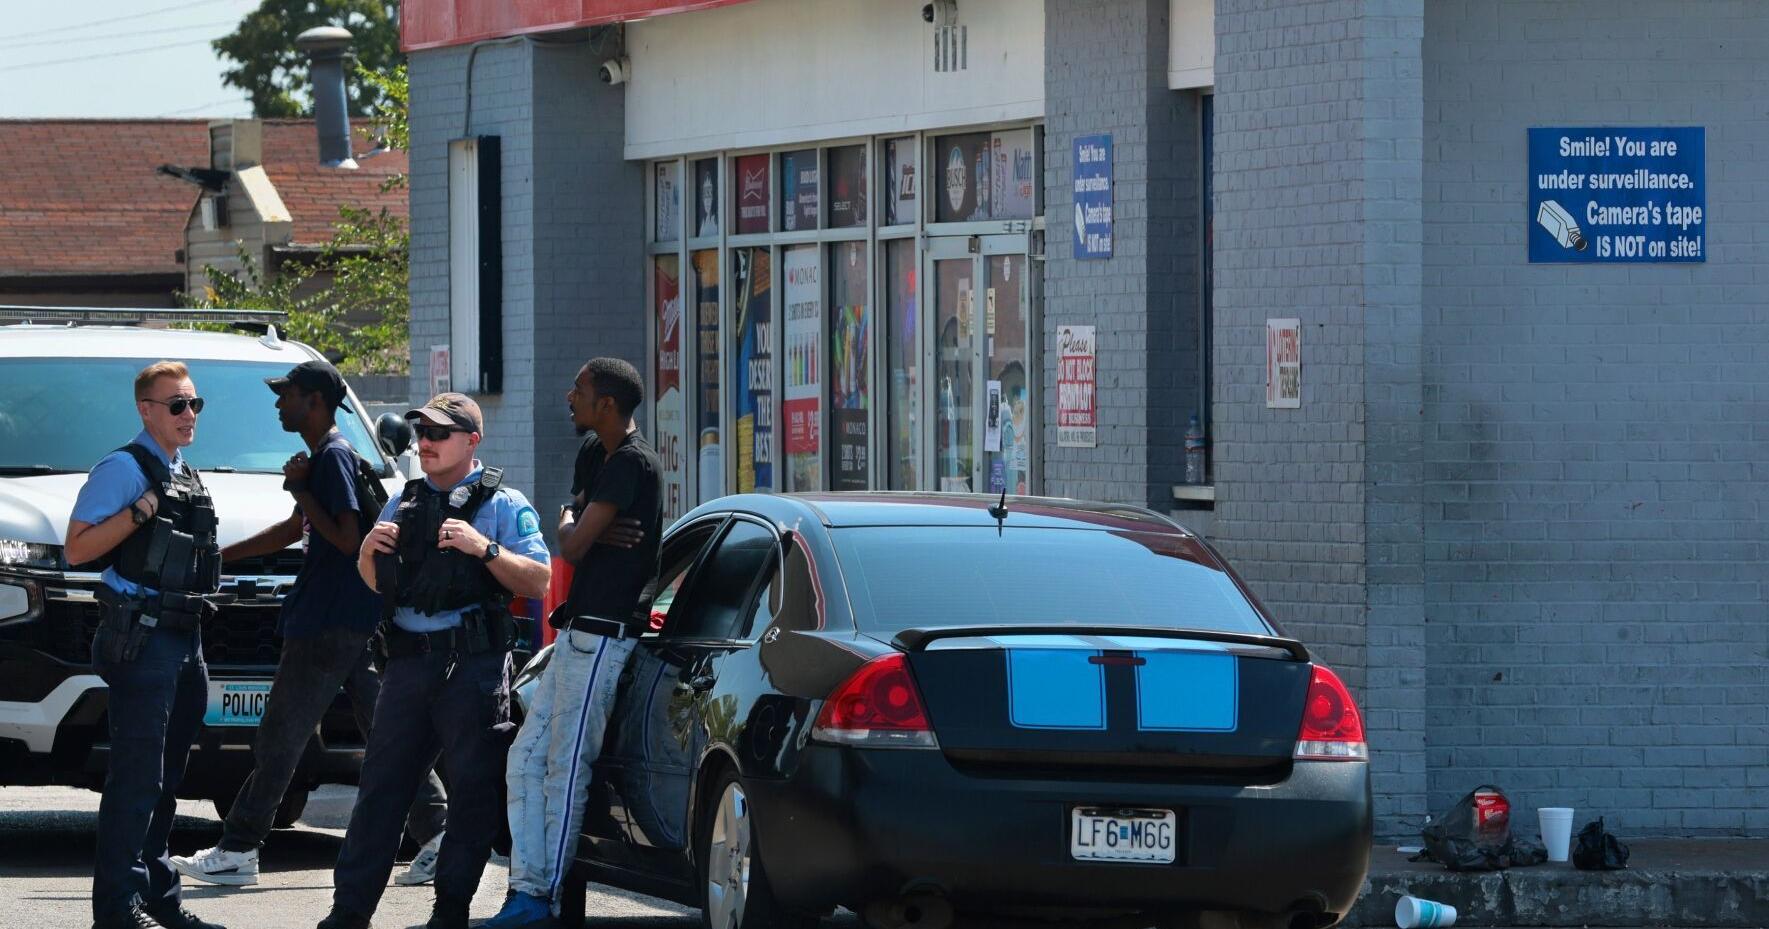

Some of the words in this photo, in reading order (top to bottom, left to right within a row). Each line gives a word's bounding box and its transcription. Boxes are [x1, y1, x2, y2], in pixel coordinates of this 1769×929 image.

[1559, 136, 1610, 157] Smile!
[1615, 136, 1646, 157] You
[1650, 140, 1677, 157] are
[1538, 169, 1585, 190] under
[1589, 169, 1694, 190] surveillance.
[1586, 200, 1662, 225] Camera's
[1665, 201, 1702, 230] tape
[1596, 235, 1611, 257] IS
[1614, 235, 1646, 257] NOT
[1648, 240, 1666, 257] on
[1669, 235, 1702, 257] site!
[756, 322, 772, 352] YOU
[1062, 328, 1088, 353] Please
[757, 396, 771, 427] THE
[1078, 818, 1119, 848] LF6
[1130, 820, 1171, 850] M6G
